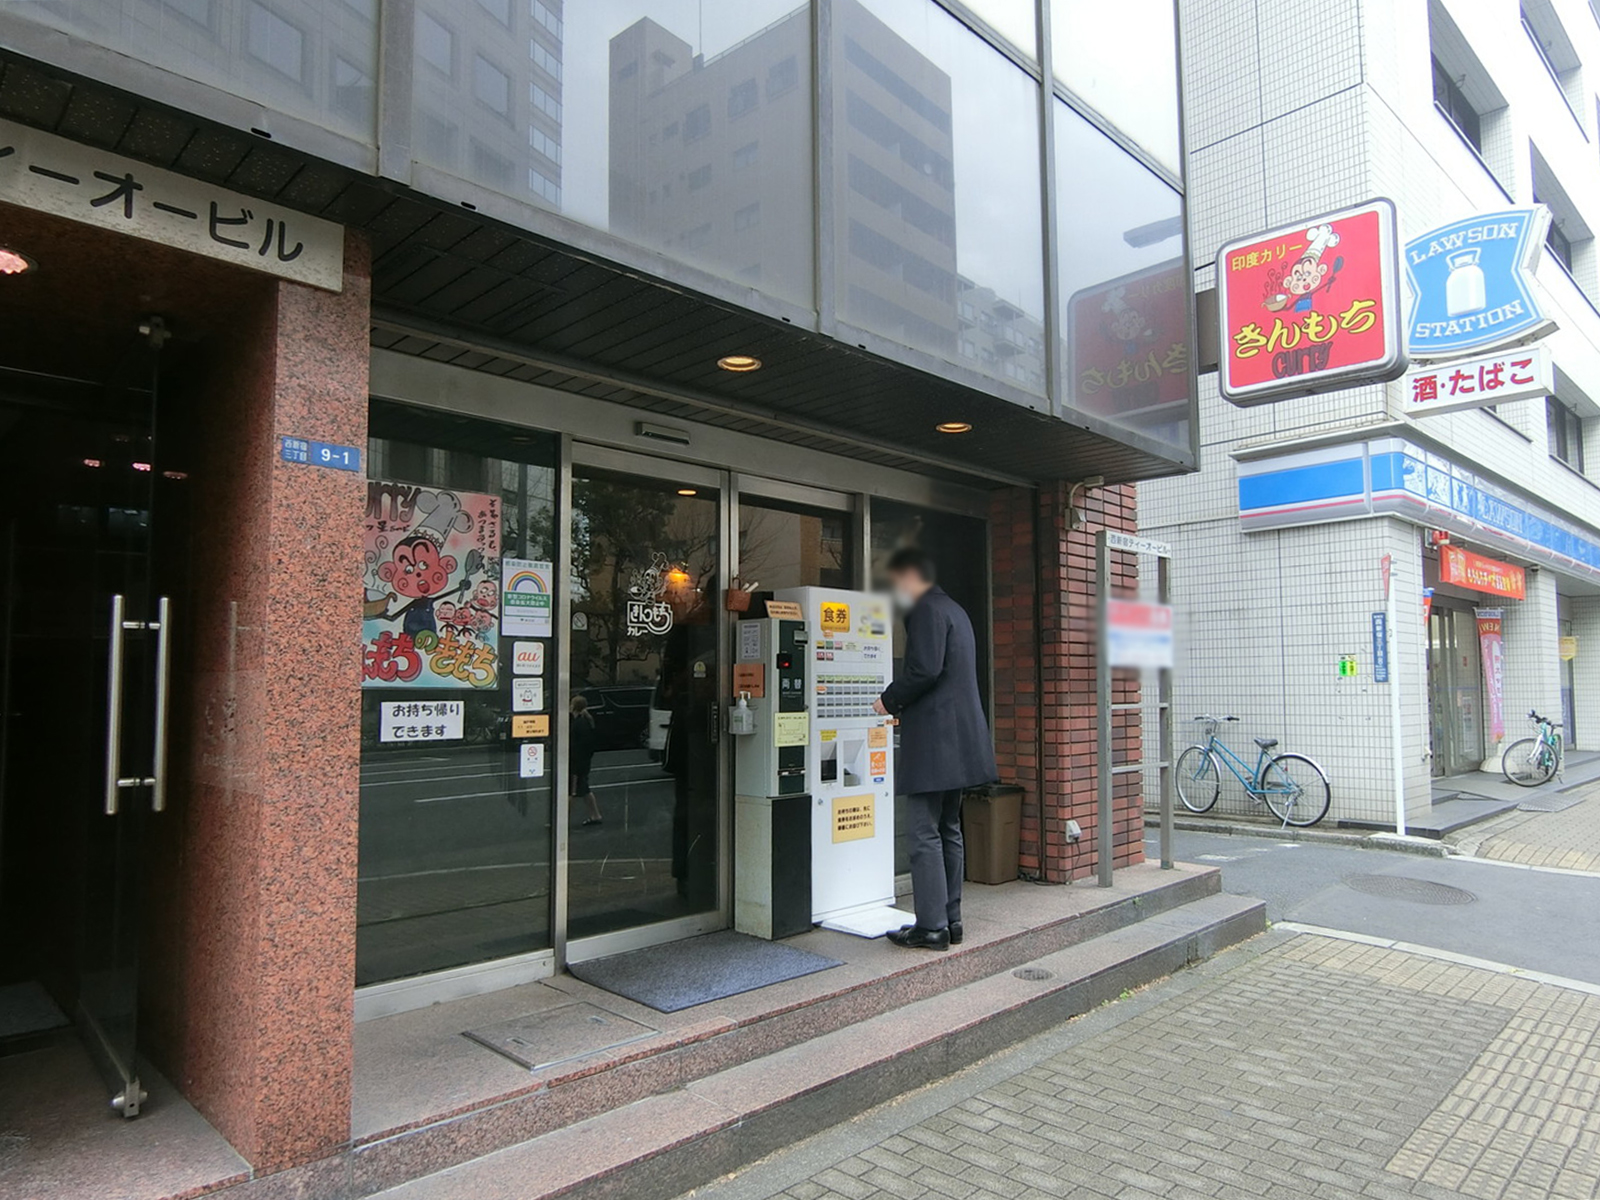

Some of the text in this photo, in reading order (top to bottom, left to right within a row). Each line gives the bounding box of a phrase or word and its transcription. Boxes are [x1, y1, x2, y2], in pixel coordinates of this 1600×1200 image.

[0, 145, 304, 263] ーオービル
[1411, 221, 1520, 266] LAWSON
[1231, 241, 1304, 273] 印度カリー
[1414, 298, 1525, 341] STATION
[1233, 298, 1377, 360] きんもち
[1412, 358, 1536, 404] 酒・たばこ
[284, 439, 308, 451] 西新宿
[284, 450, 308, 462] 三丁目
[321, 448, 349, 465] 9-1
[630, 602, 670, 632] きんもち
[823, 607, 847, 624] 食券
[627, 627, 649, 636] カレー
[517, 651, 540, 662] au
[392, 703, 460, 717] お持ち帰り
[392, 725, 447, 738] できます
